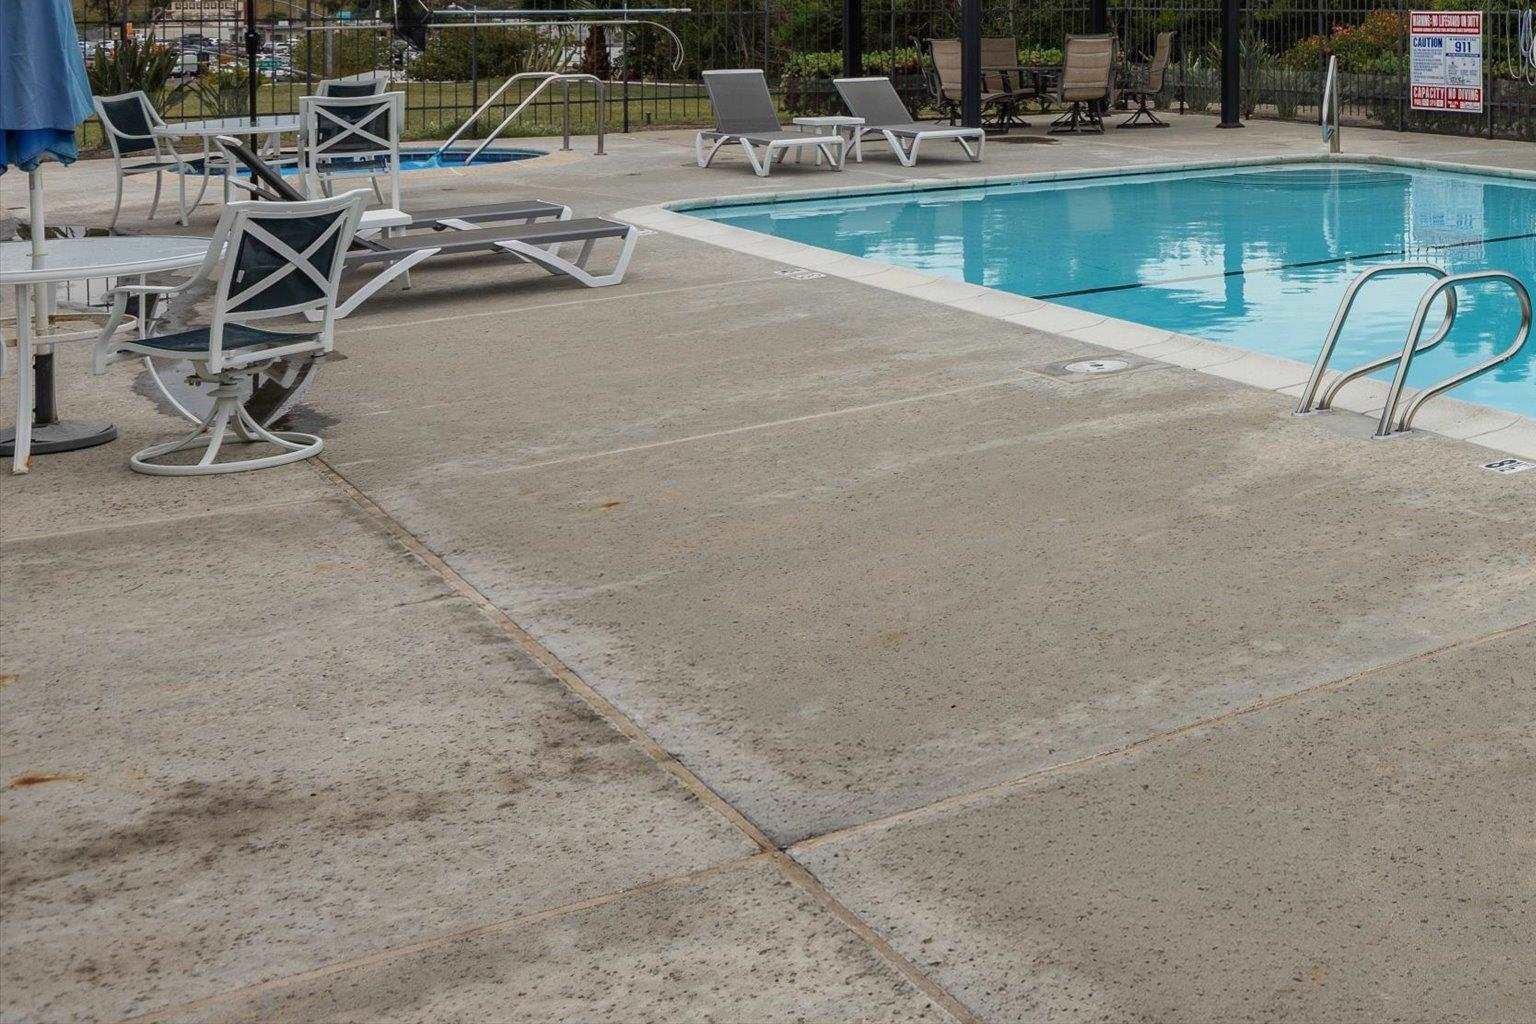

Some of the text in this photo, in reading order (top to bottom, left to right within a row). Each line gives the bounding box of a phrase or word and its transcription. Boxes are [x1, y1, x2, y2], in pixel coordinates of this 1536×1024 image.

[1413, 38, 1443, 48] CAUTION
[1454, 42, 1471, 53] 911
[1413, 86, 1445, 100] CAPACITY
[1448, 87, 1457, 100] NO
